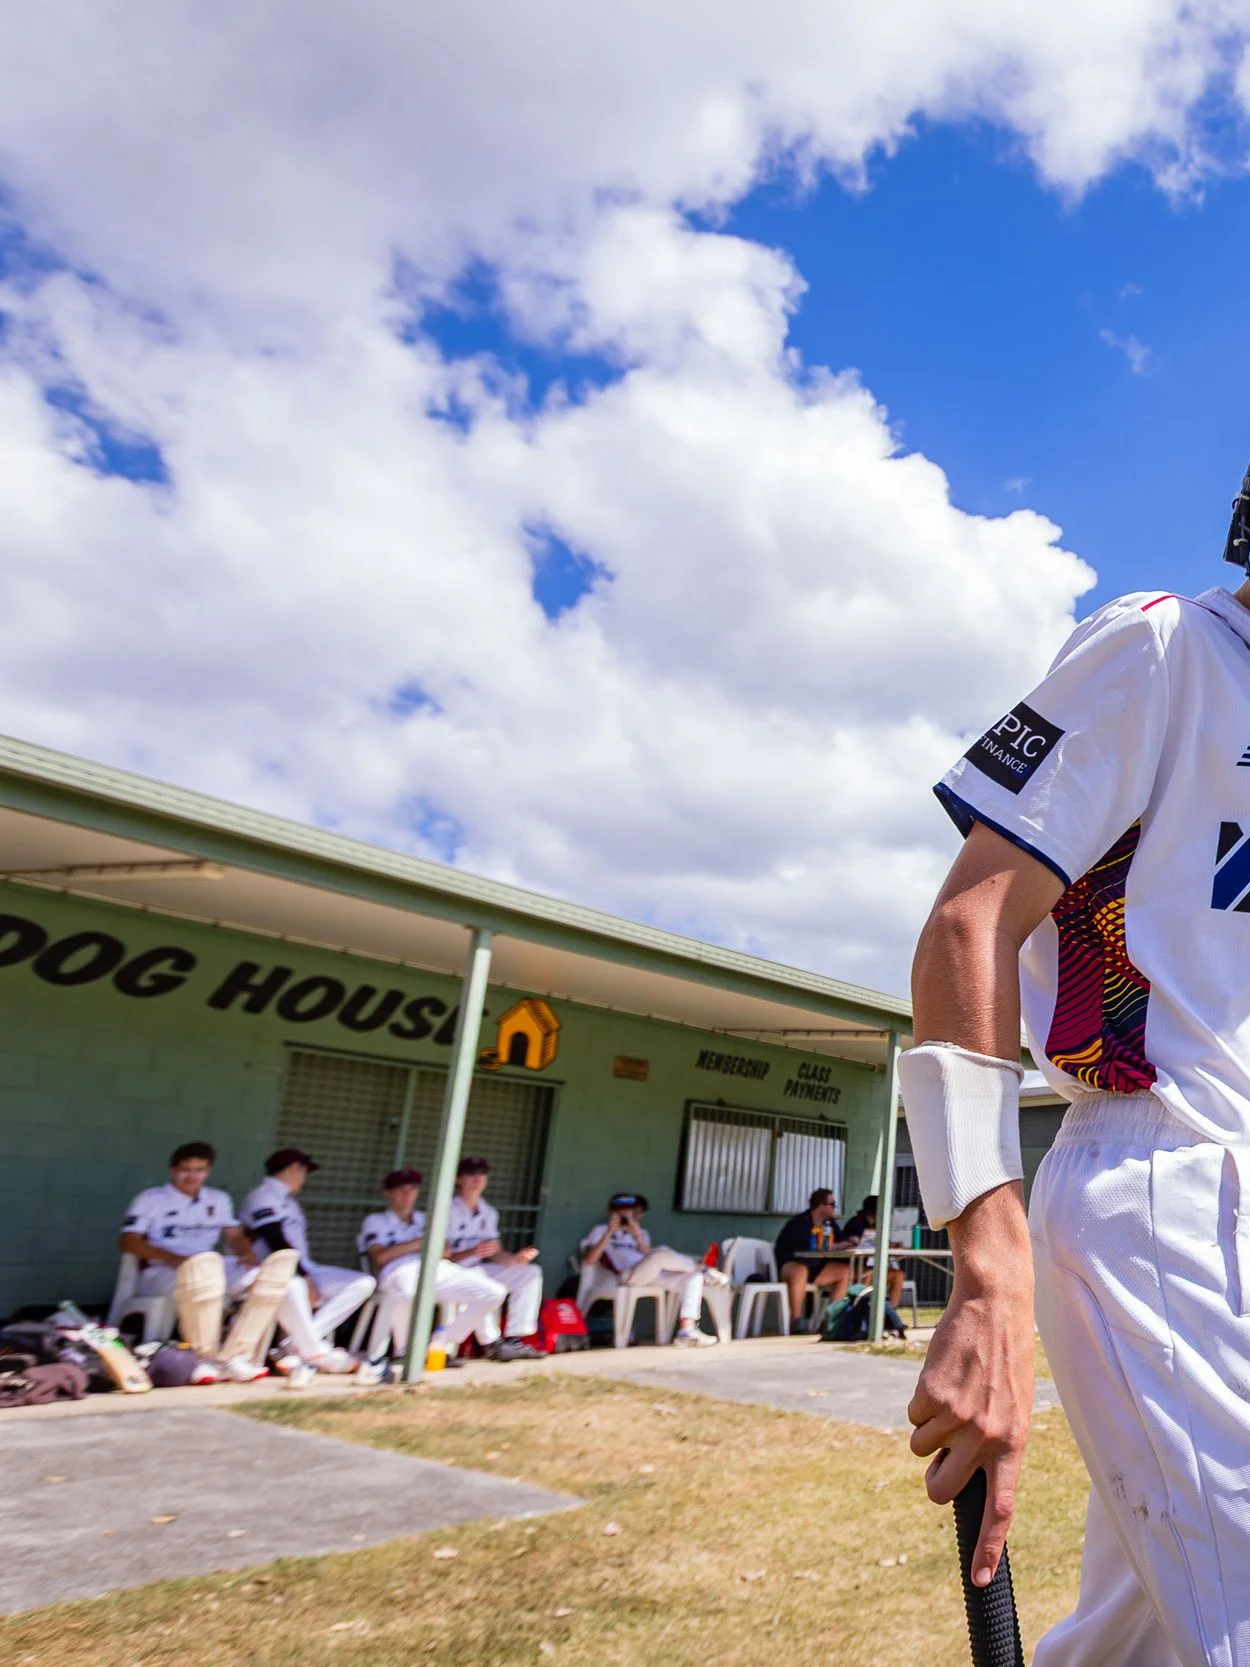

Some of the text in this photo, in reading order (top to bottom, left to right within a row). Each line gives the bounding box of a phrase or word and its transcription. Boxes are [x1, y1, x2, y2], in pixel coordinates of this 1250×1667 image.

[992, 713, 1047, 757] PIC
[695, 1049, 770, 1081] MEMBERSHIP
[797, 1062, 832, 1083] CLASS
[783, 1078, 841, 1105] PAYMENTS
